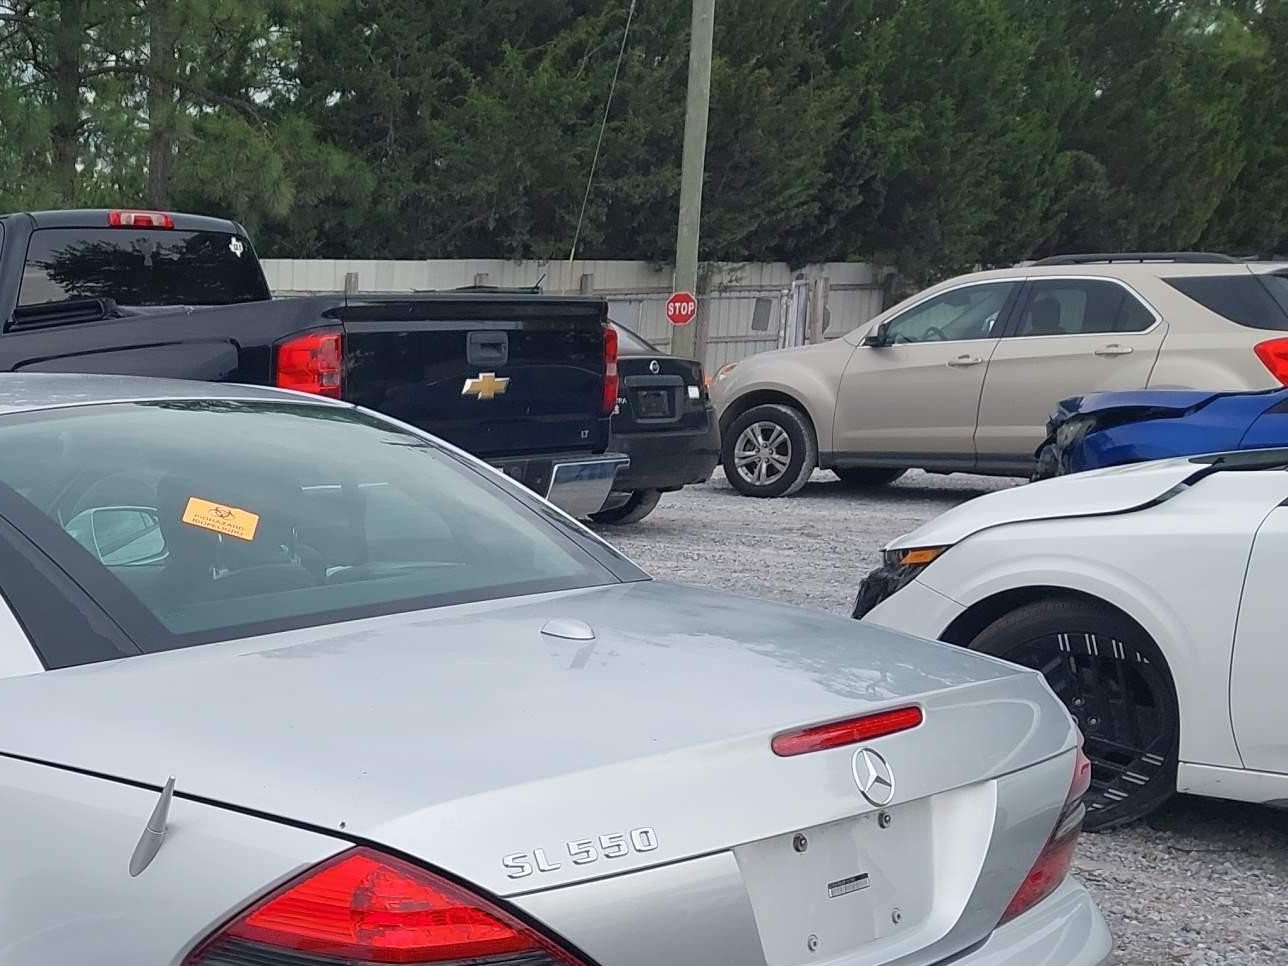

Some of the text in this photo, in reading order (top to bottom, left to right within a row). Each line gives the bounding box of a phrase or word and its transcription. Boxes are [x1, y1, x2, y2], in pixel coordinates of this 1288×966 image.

[668, 302, 695, 316] STOP
[581, 430, 590, 438] LT
[502, 826, 659, 879] SL 550
